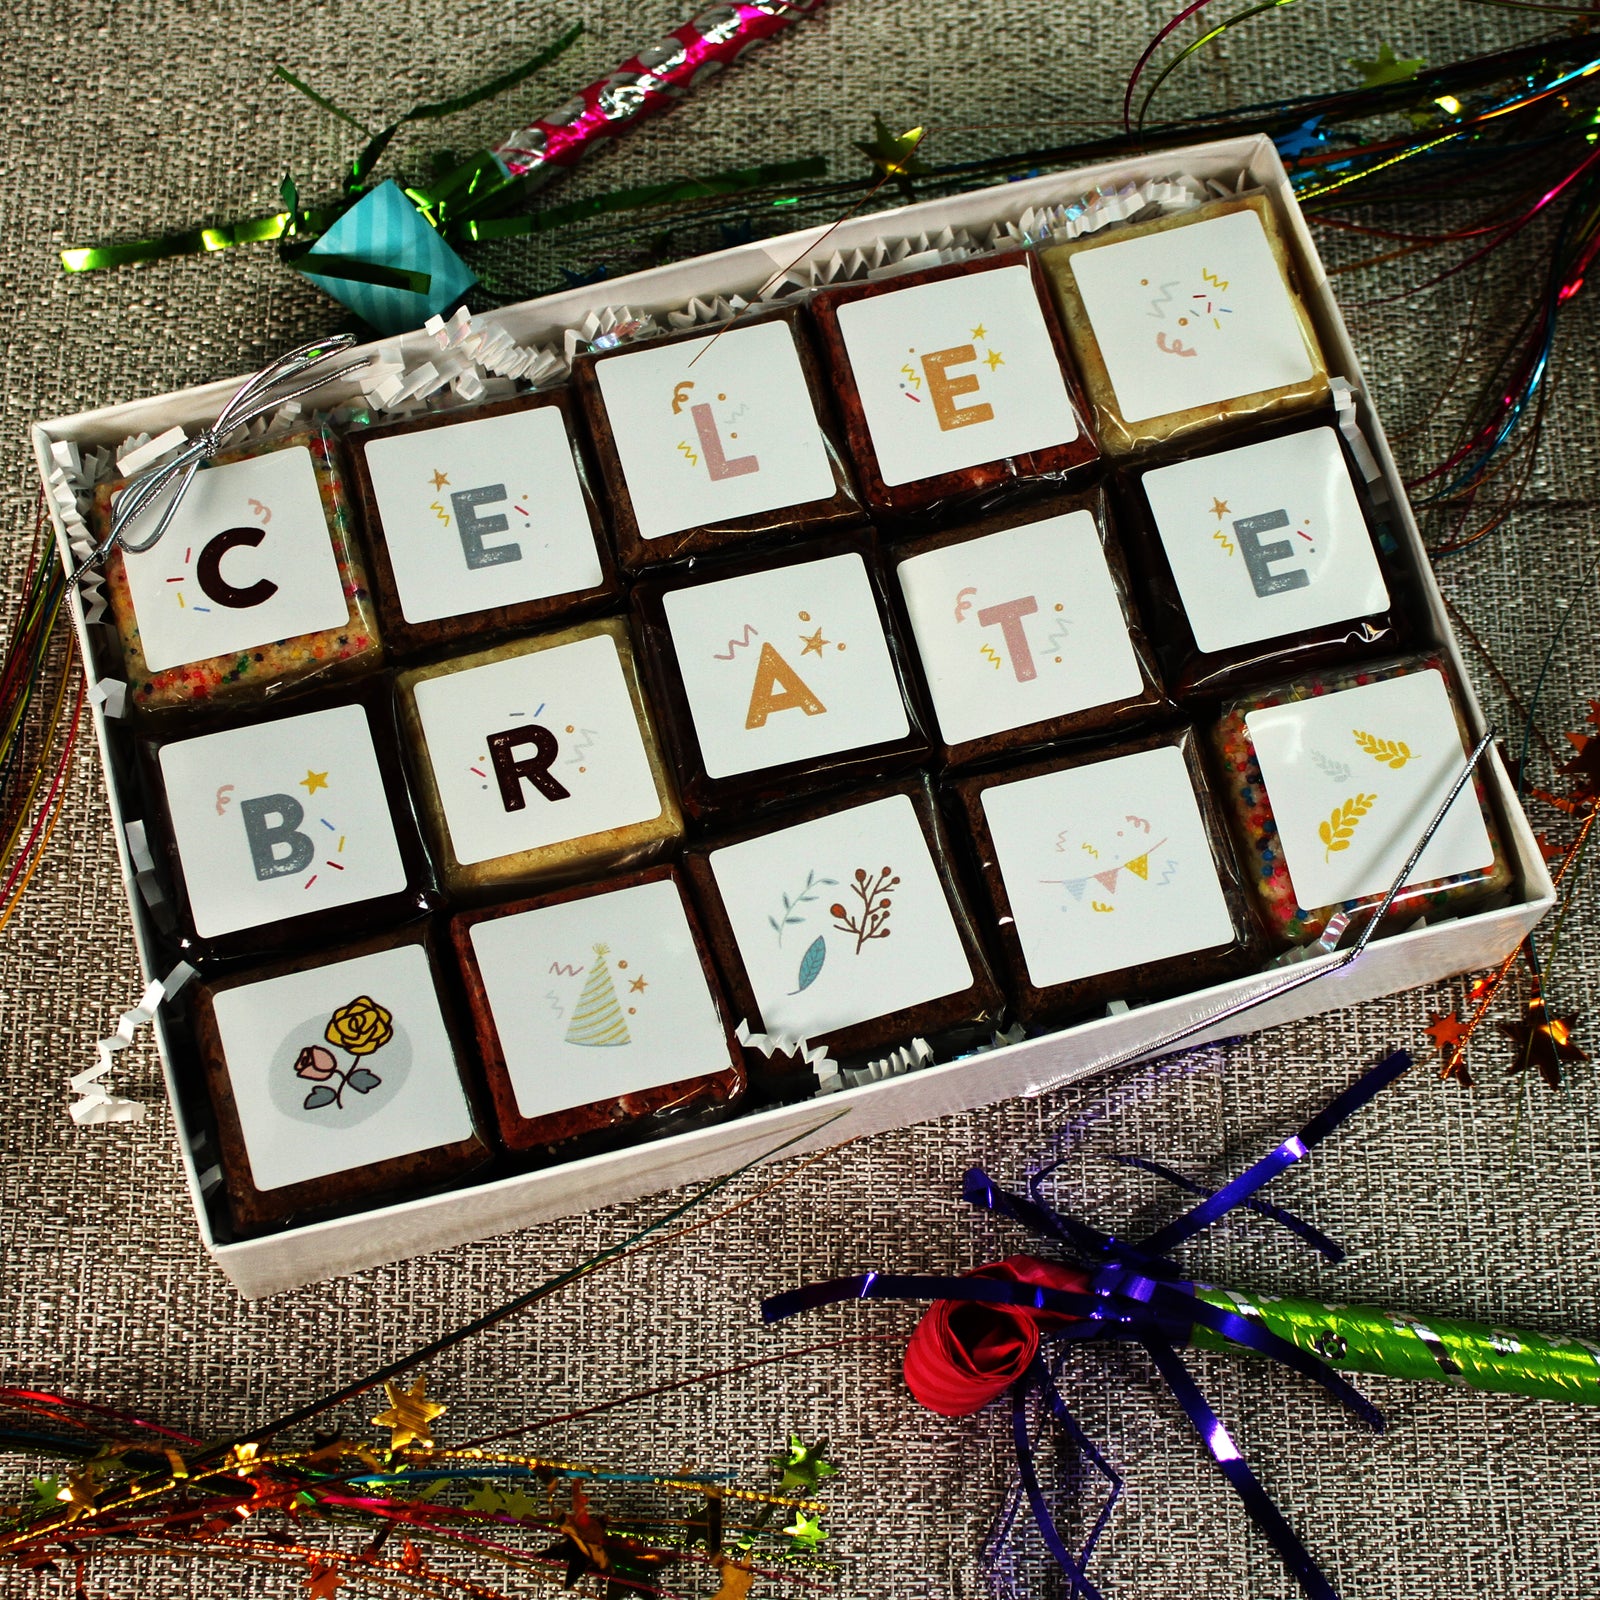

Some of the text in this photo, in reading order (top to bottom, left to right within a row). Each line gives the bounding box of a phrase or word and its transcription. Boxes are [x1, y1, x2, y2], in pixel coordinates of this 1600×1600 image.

[196, 343, 995, 610] C E L E
[239, 508, 1310, 882] B R A T E
